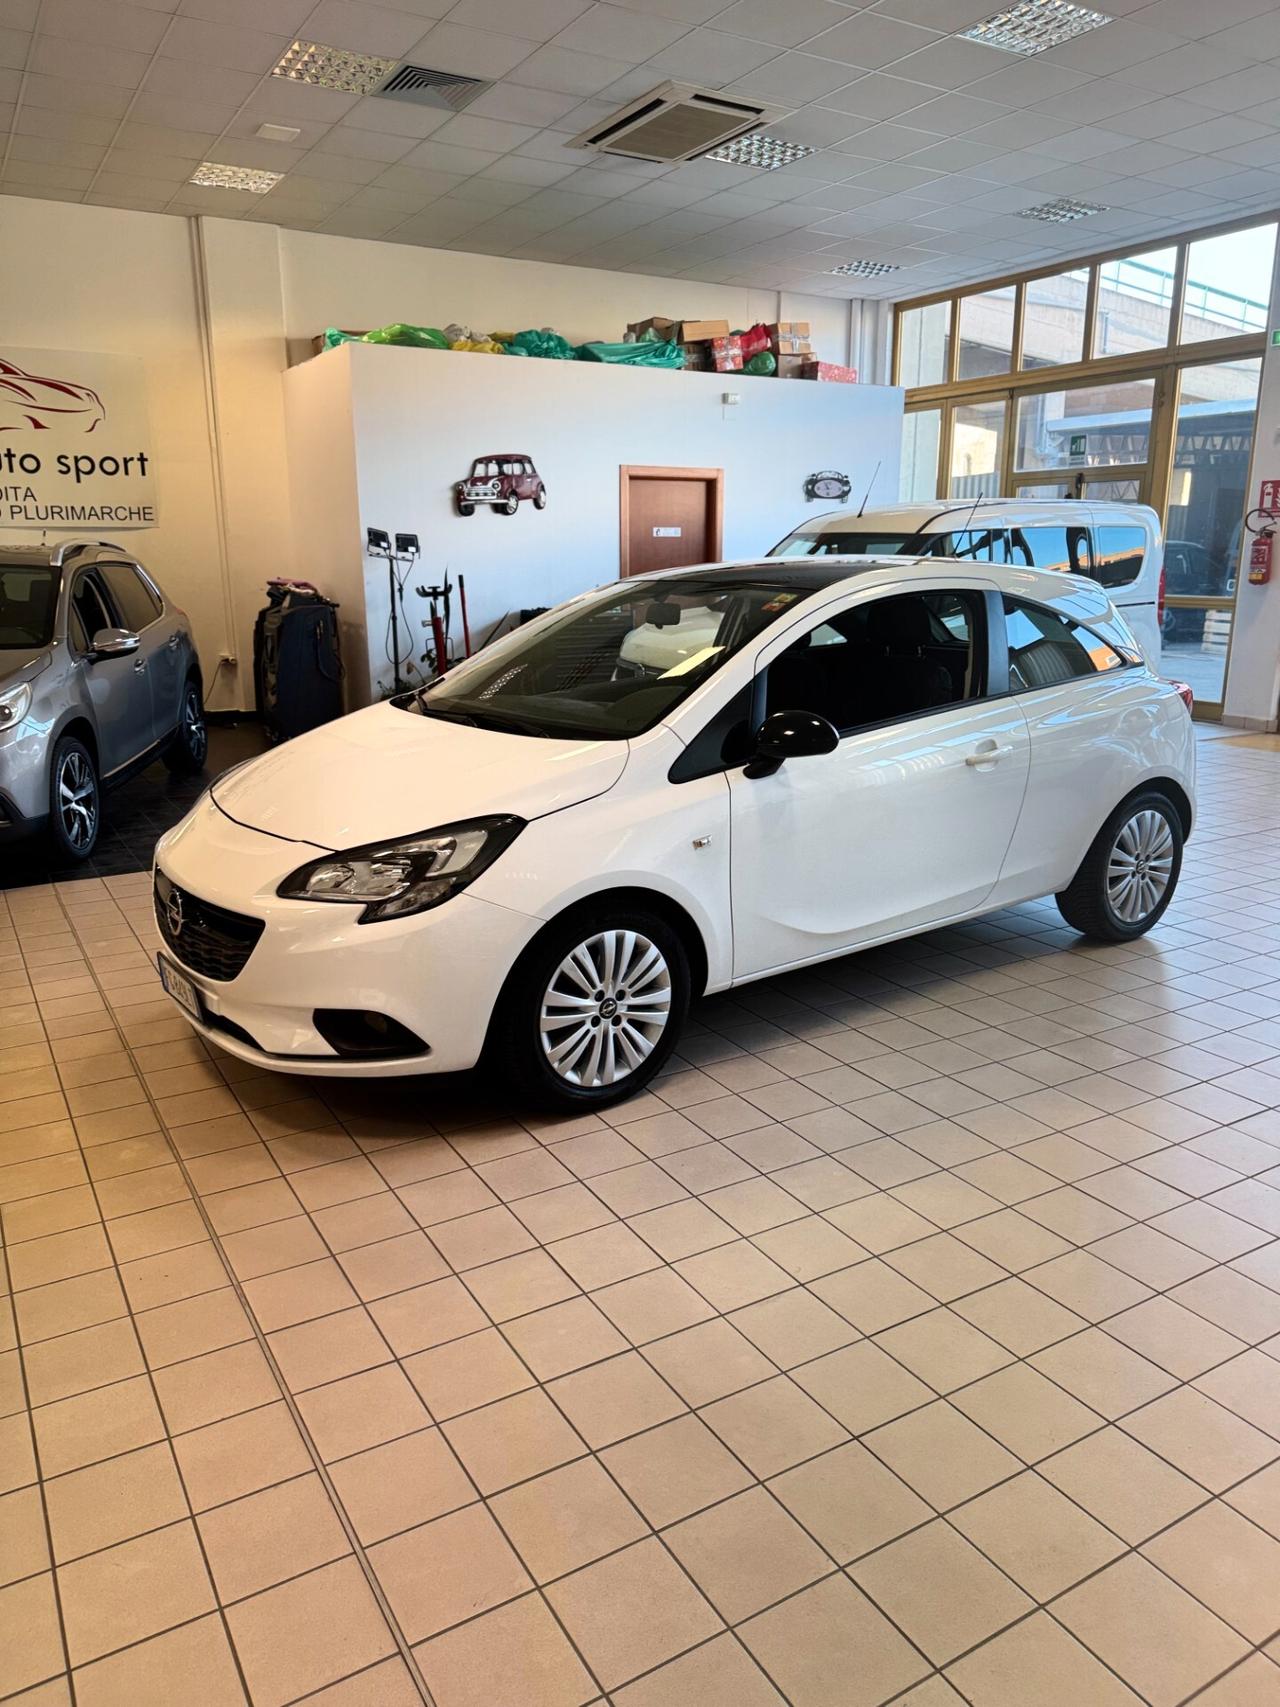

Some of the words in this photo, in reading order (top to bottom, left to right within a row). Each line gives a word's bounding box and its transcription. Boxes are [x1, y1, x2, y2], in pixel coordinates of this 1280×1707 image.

[0, 447, 41, 474] to
[56, 452, 149, 484] sport
[0, 486, 37, 502] ITA
[10, 504, 155, 522] PLURIMARCHE
